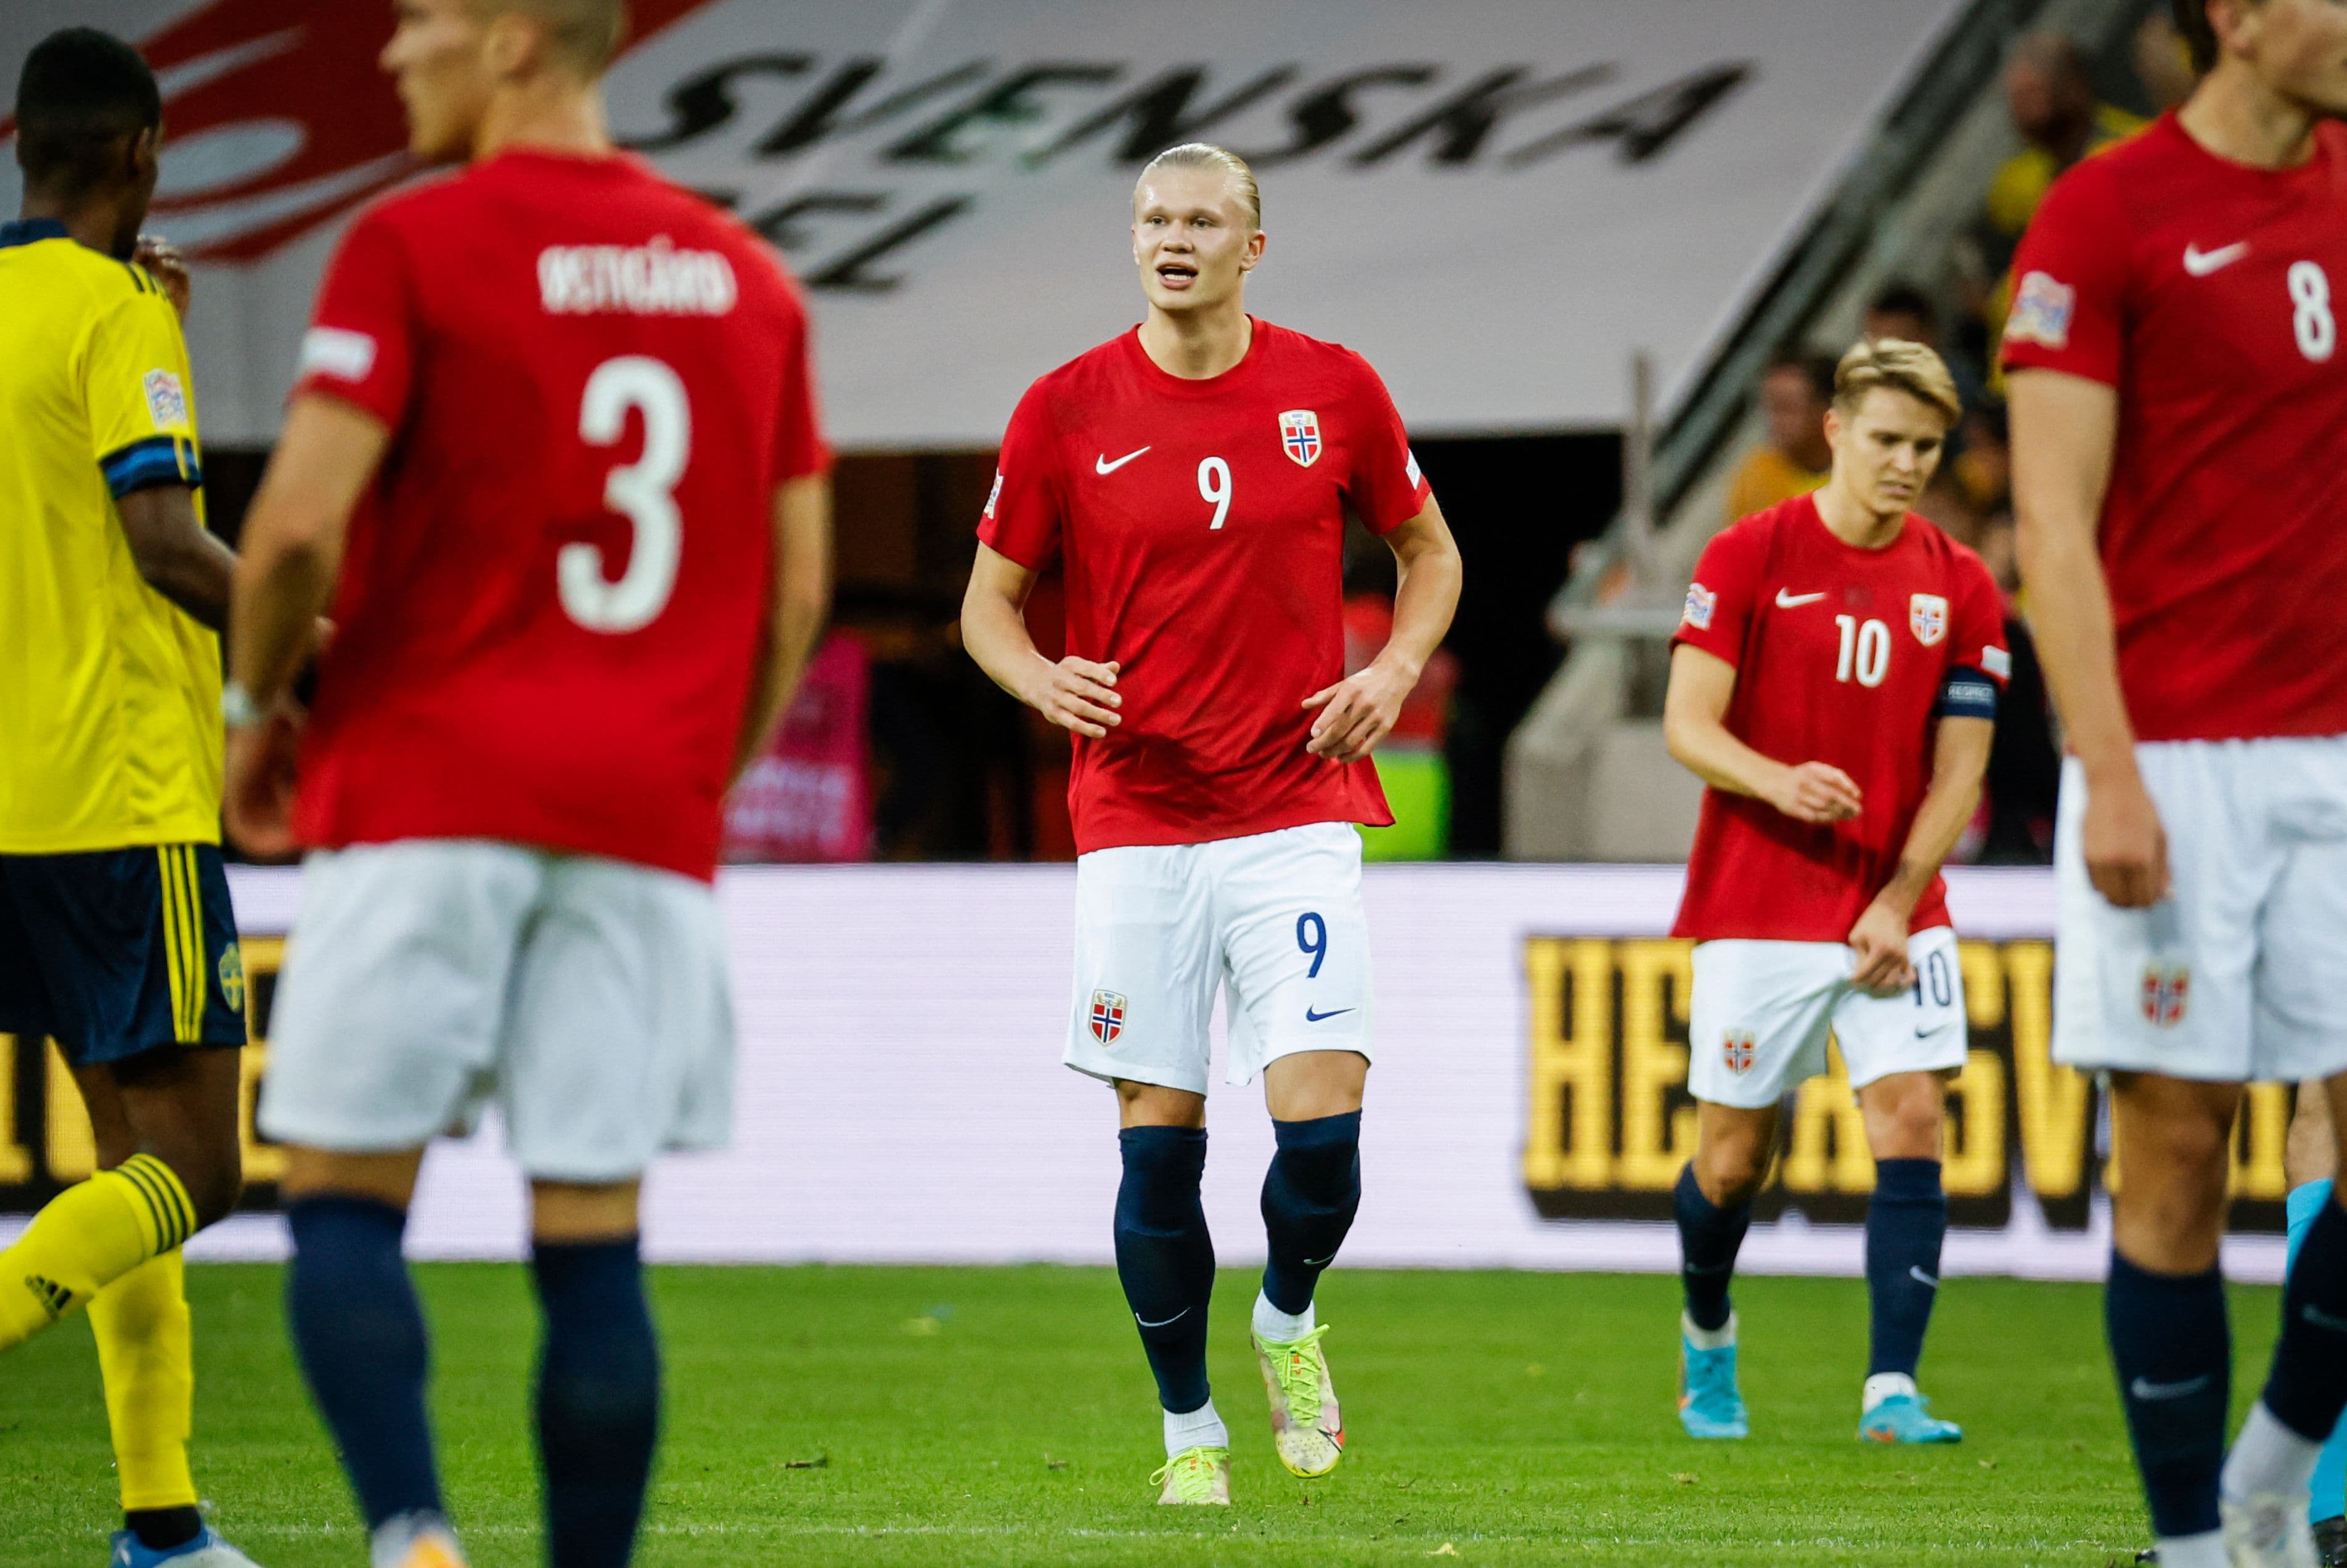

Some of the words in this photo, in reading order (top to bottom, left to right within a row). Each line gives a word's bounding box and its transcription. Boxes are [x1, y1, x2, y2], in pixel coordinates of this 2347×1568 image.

[618, 51, 1757, 170] SVENSKA
[2287, 261, 2335, 361] 8
[557, 355, 692, 634] 3
[1197, 456, 1232, 530] 9
[1835, 614, 1891, 688] 10
[1296, 912, 1327, 978] 9
